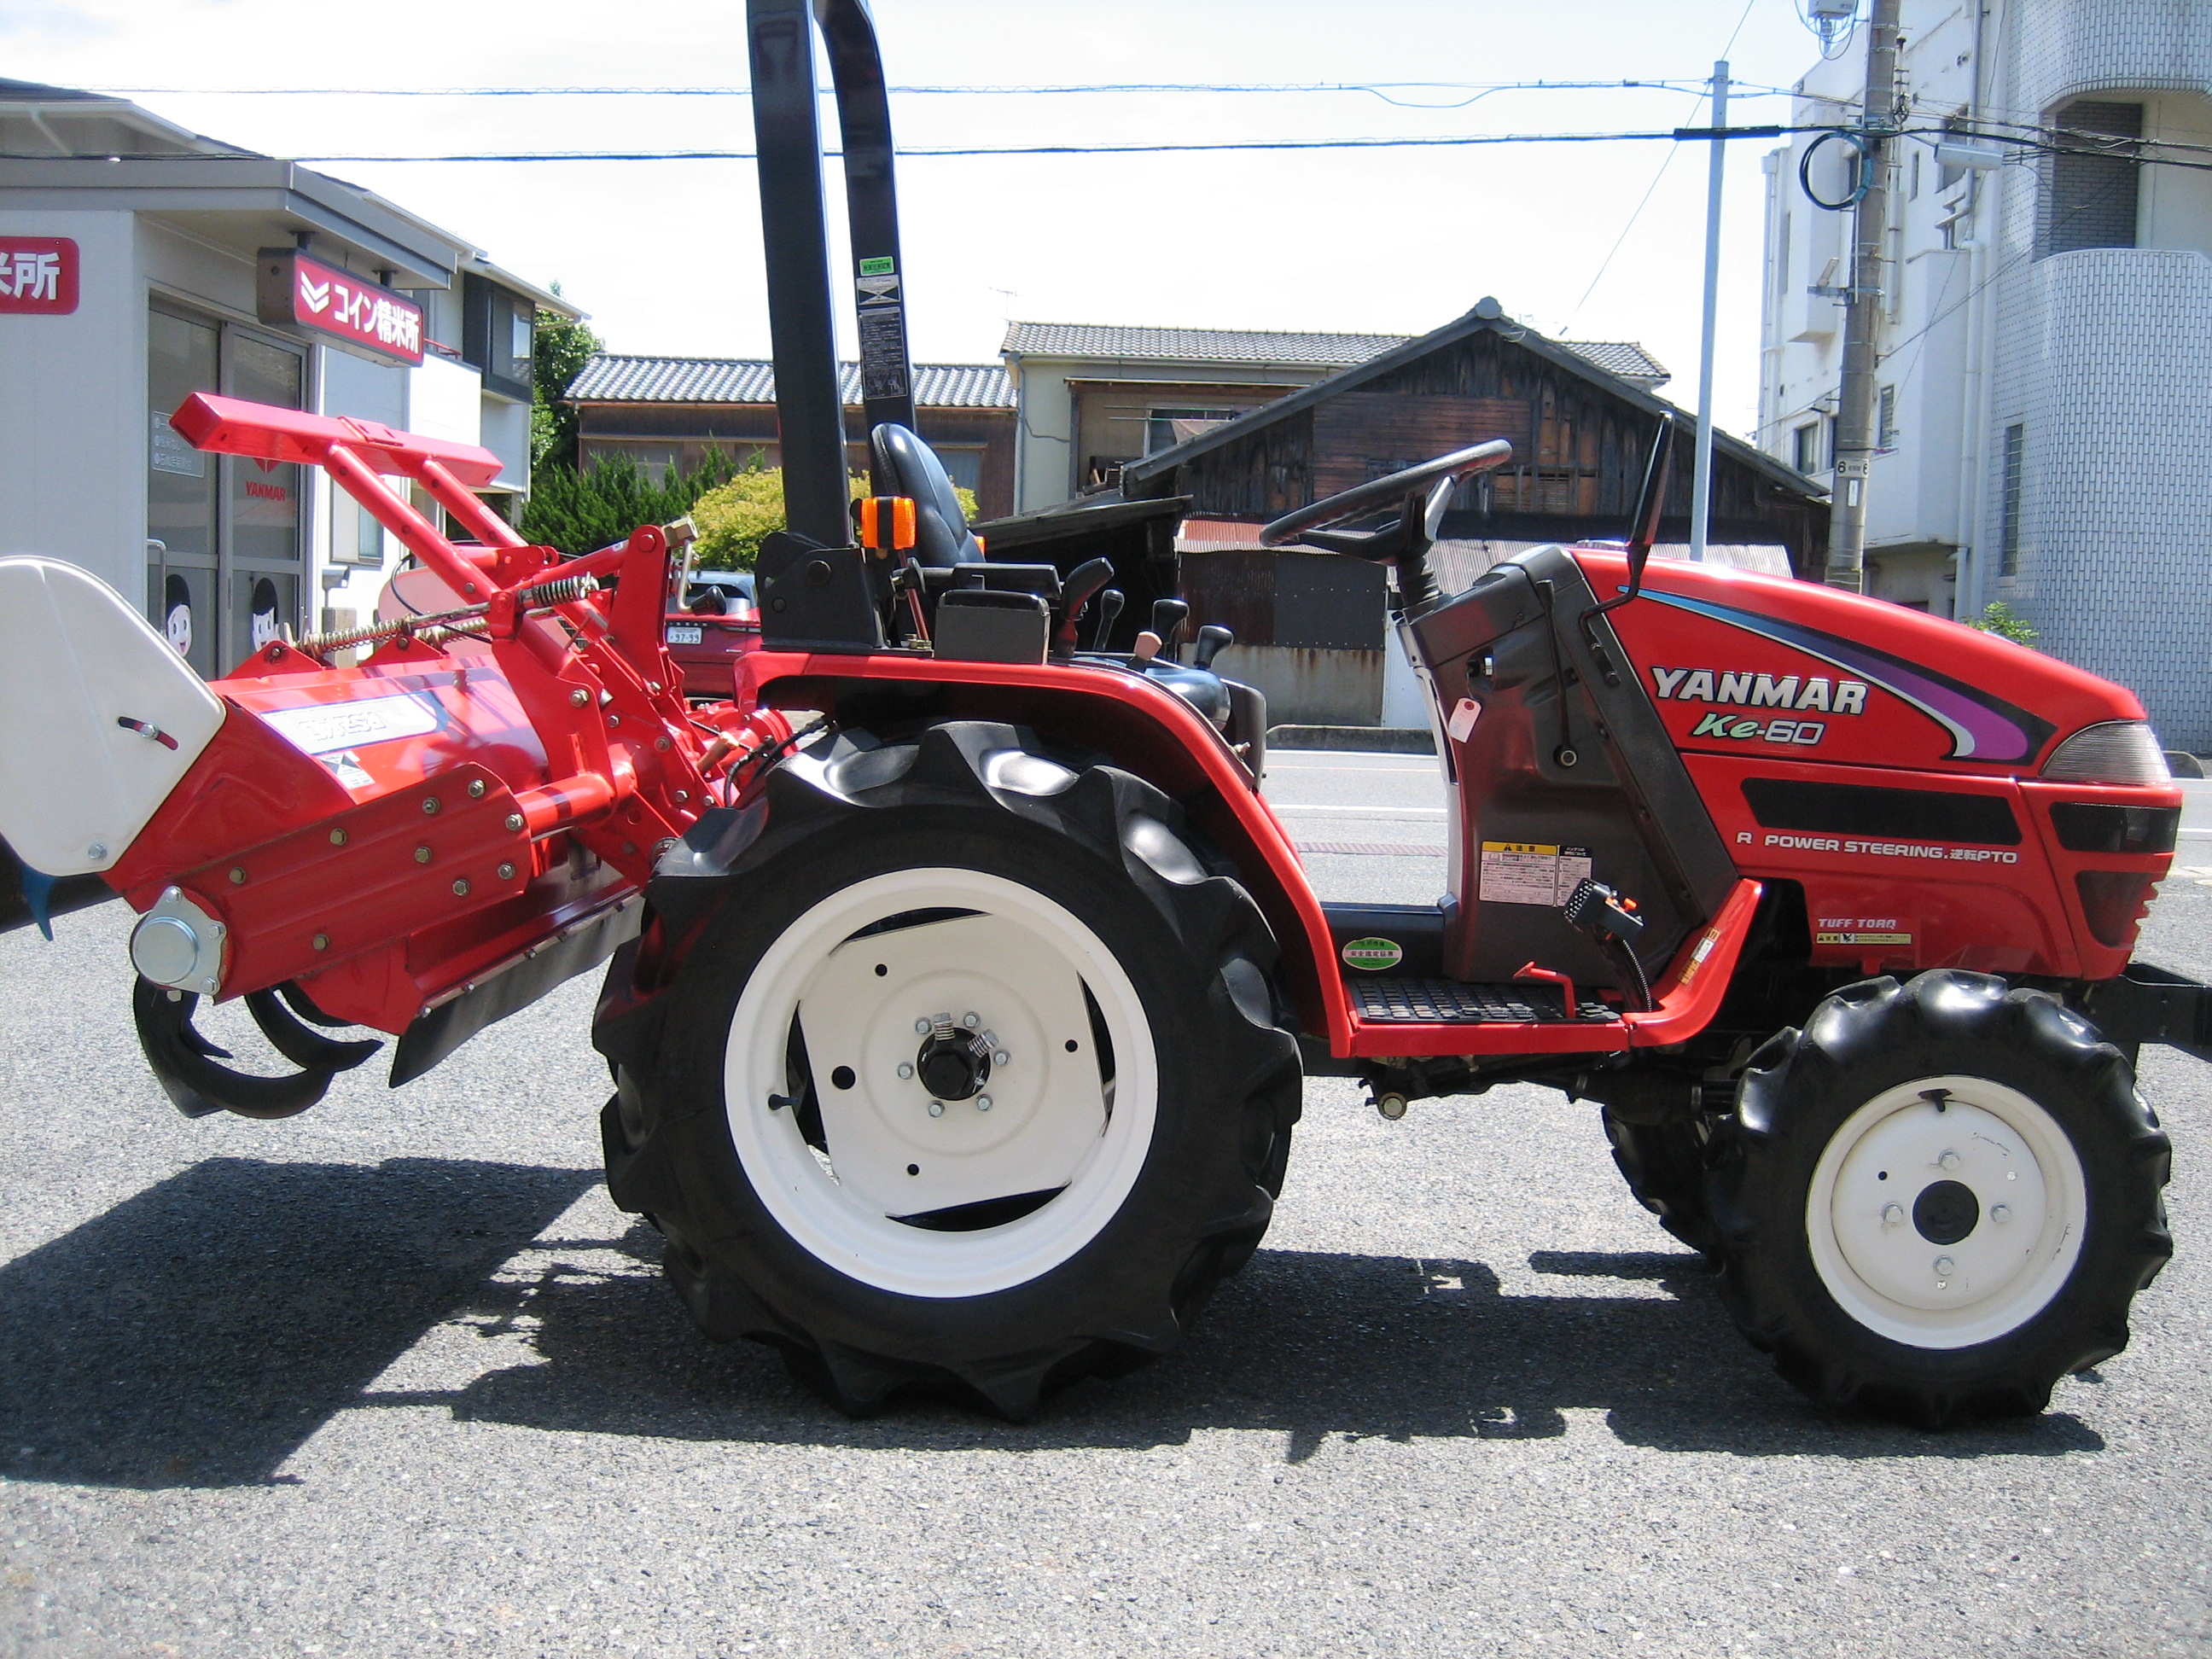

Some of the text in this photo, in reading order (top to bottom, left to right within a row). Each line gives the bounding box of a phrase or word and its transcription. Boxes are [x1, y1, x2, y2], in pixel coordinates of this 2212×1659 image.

[334, 283, 420, 354] コイン精米所
[246, 480, 287, 502] YANMAR
[1651, 667, 1869, 715] YANMAR
[1691, 713, 1826, 745] Ke-60
[1737, 831, 1752, 844] R
[1764, 835, 1839, 852] POWER
[1818, 918, 1853, 928] TUFF
